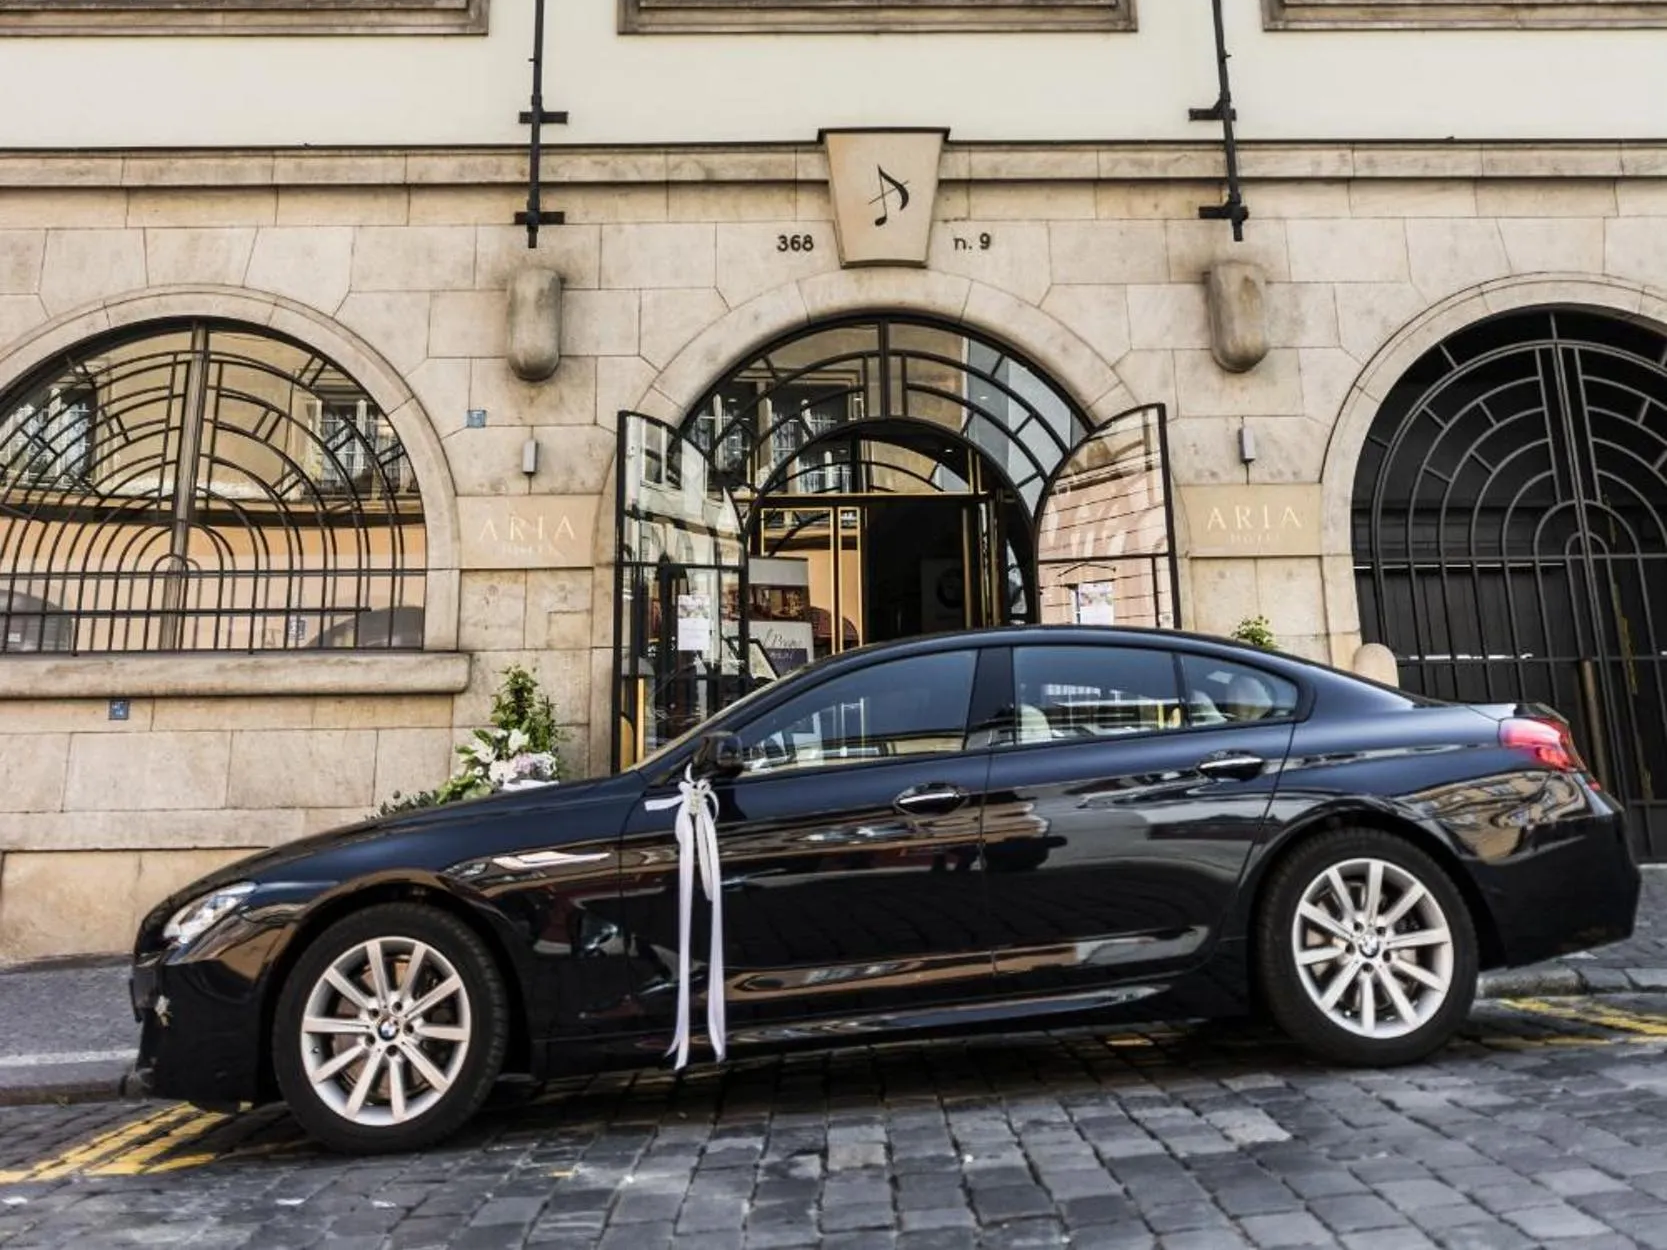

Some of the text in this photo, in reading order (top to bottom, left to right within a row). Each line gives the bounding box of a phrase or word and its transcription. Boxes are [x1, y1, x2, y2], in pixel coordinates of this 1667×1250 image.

[776, 234, 815, 252] 368
[478, 514, 576, 541] ARIA
[1206, 503, 1302, 530] ARIA
